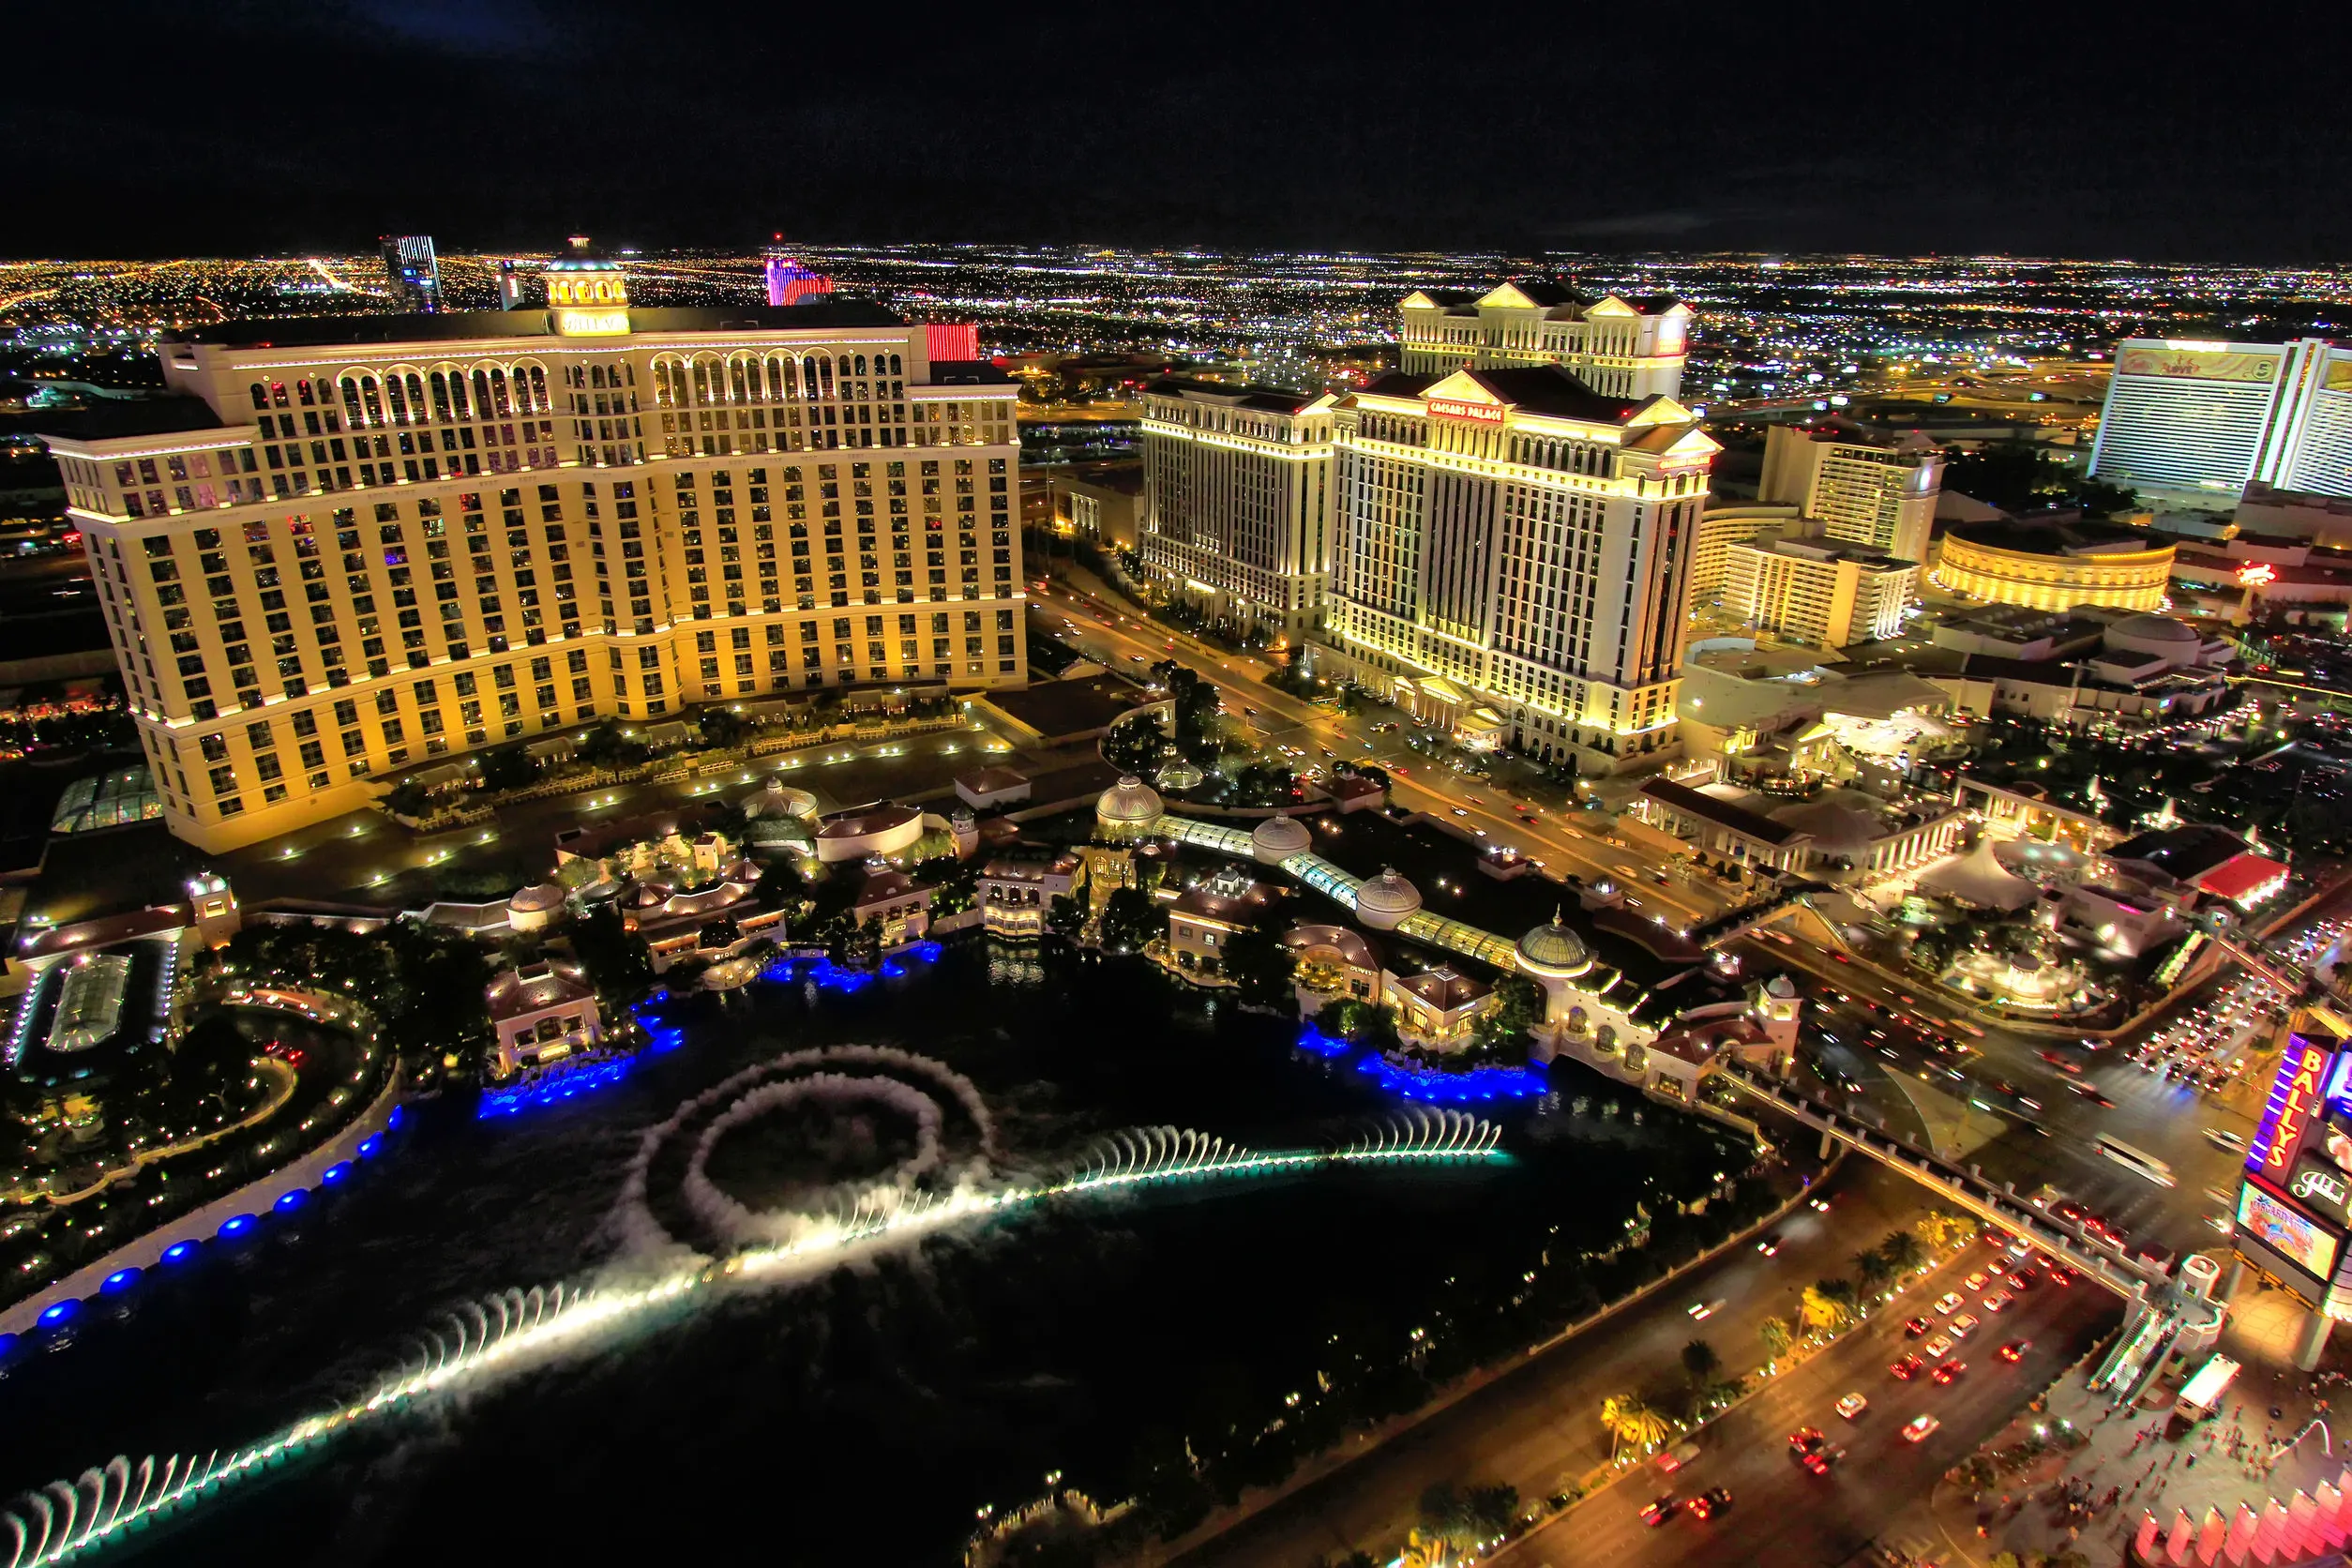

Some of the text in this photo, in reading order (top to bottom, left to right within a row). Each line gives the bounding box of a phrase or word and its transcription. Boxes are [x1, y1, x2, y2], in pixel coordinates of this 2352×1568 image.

[1430, 401, 1501, 421] CAESARS PALACE
[1349, 966, 1373, 976] OLIVES
[2267, 1048, 2323, 1168] BALLYS
